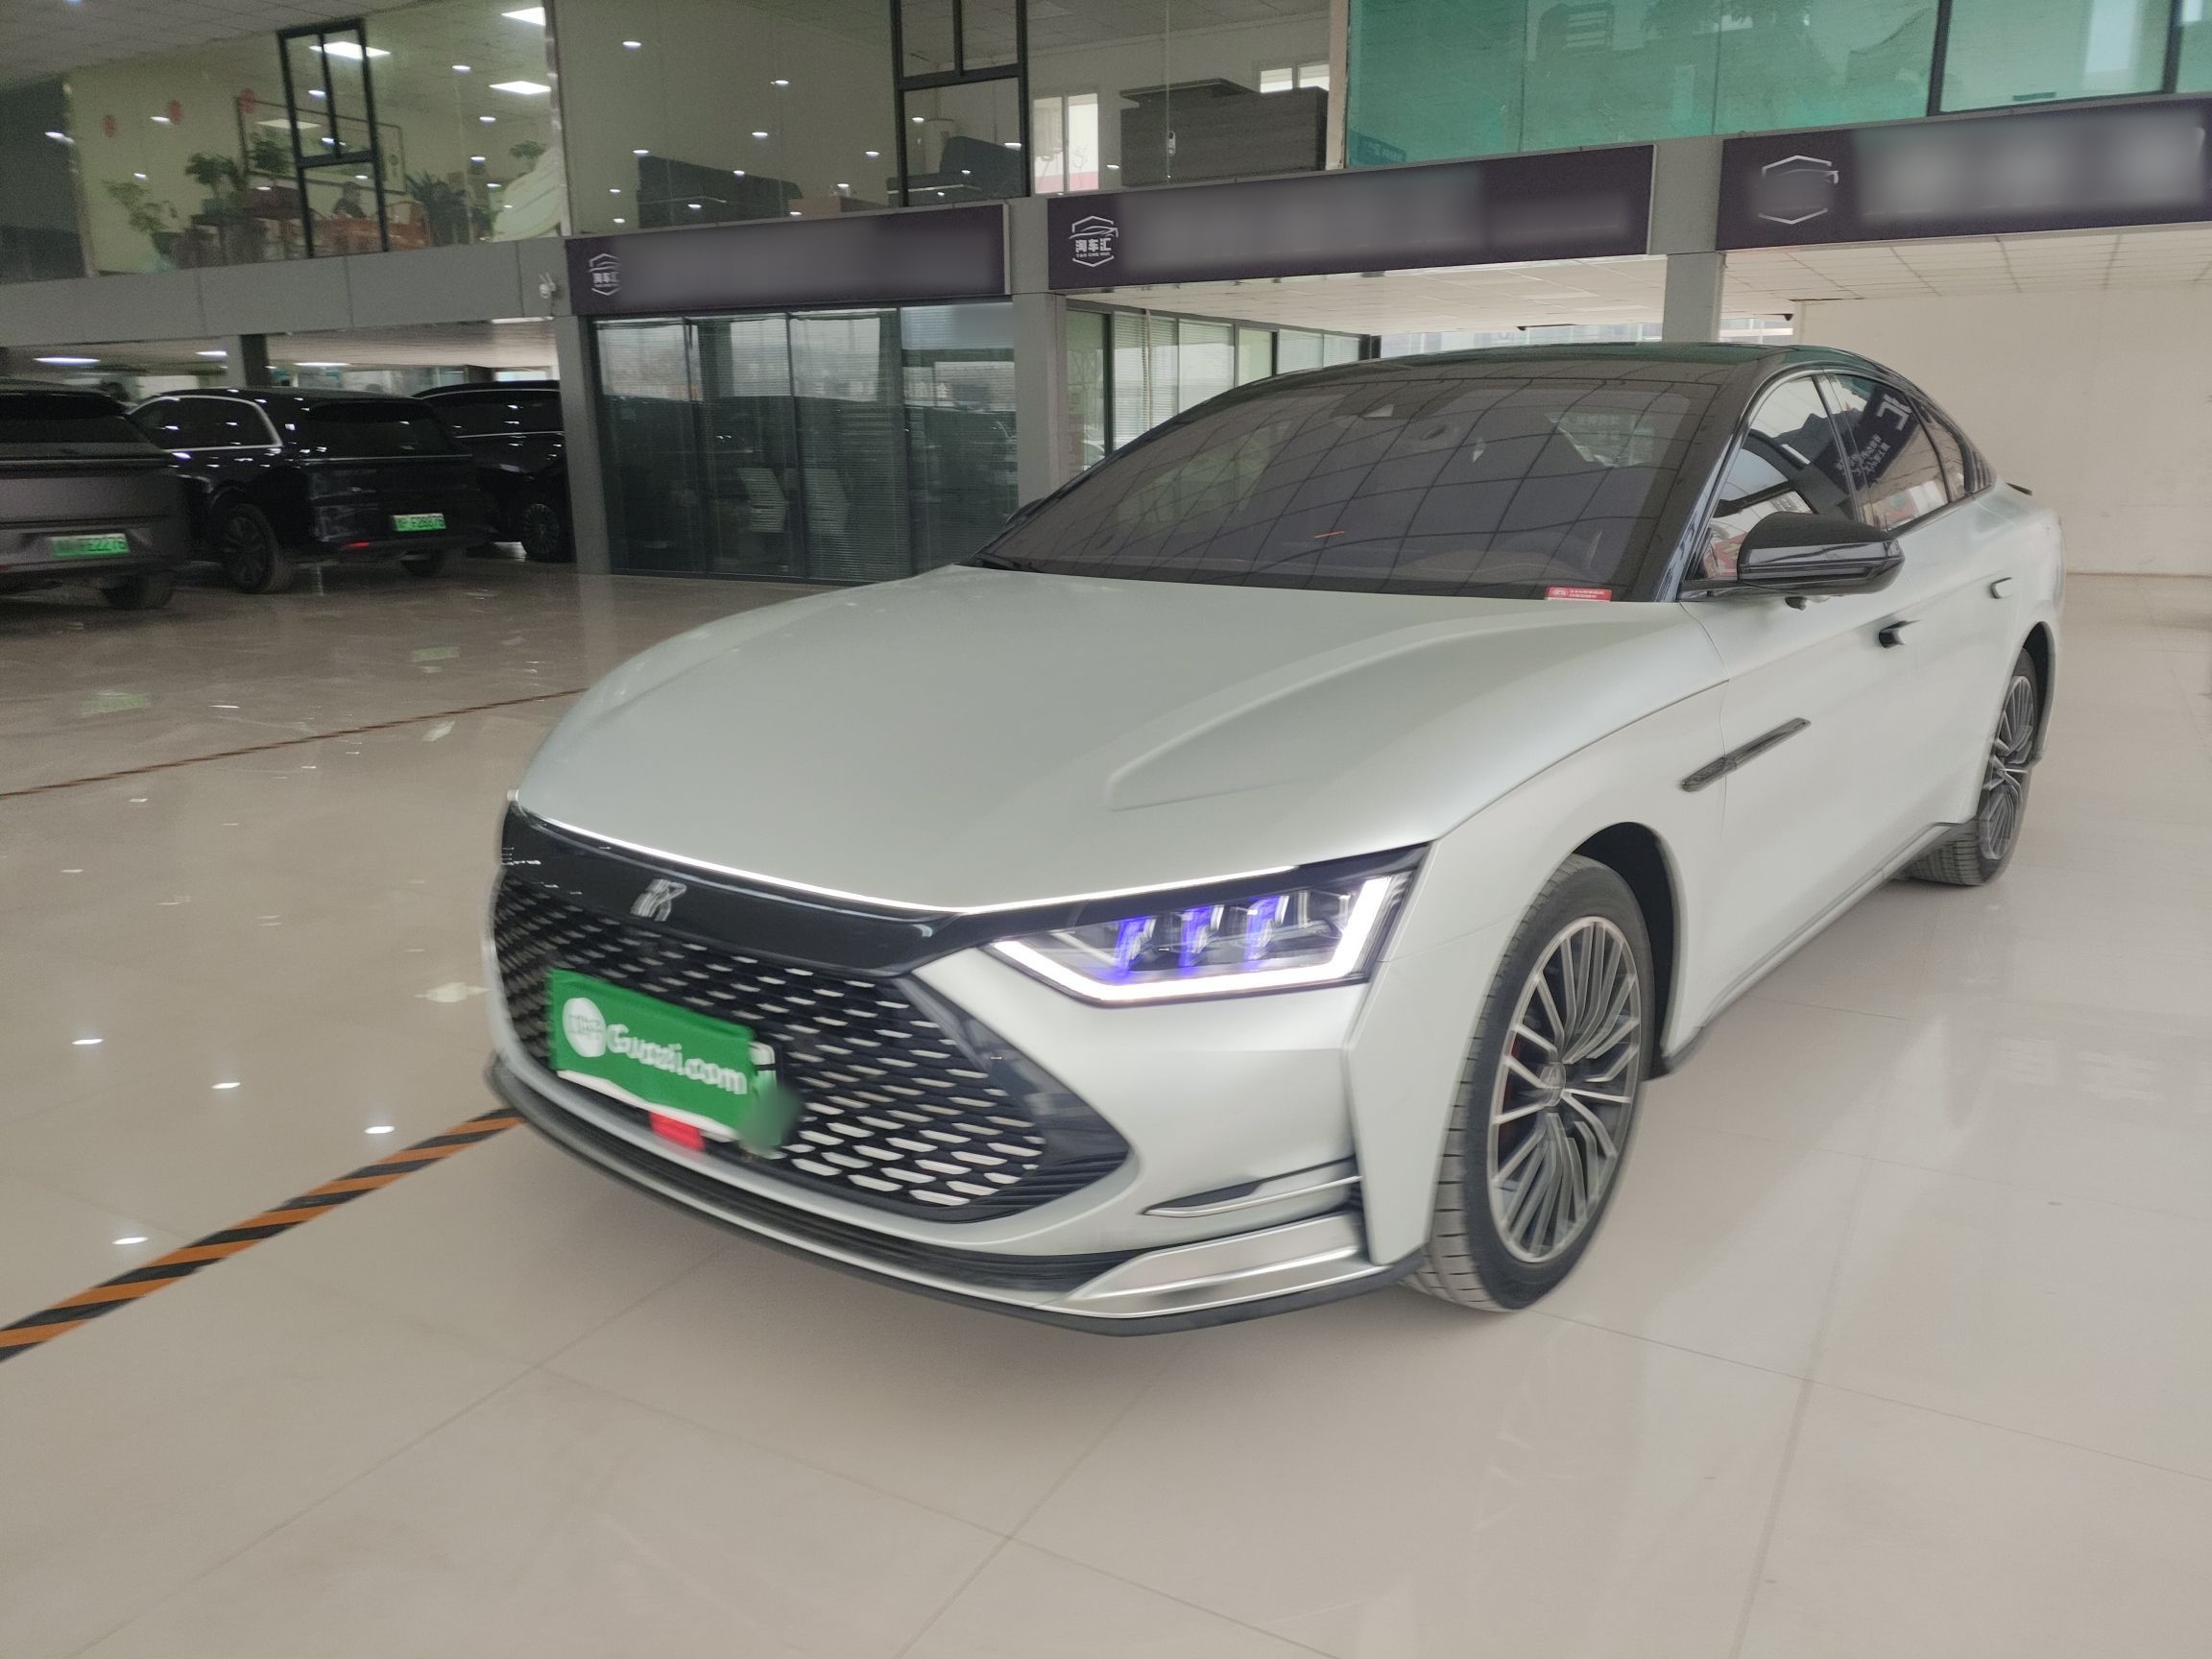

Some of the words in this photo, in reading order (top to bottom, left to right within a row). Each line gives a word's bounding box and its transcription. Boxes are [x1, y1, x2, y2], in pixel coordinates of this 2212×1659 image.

[1075, 237, 1112, 252] 淘车汇
[607, 1023, 747, 1094] Guazi.com
